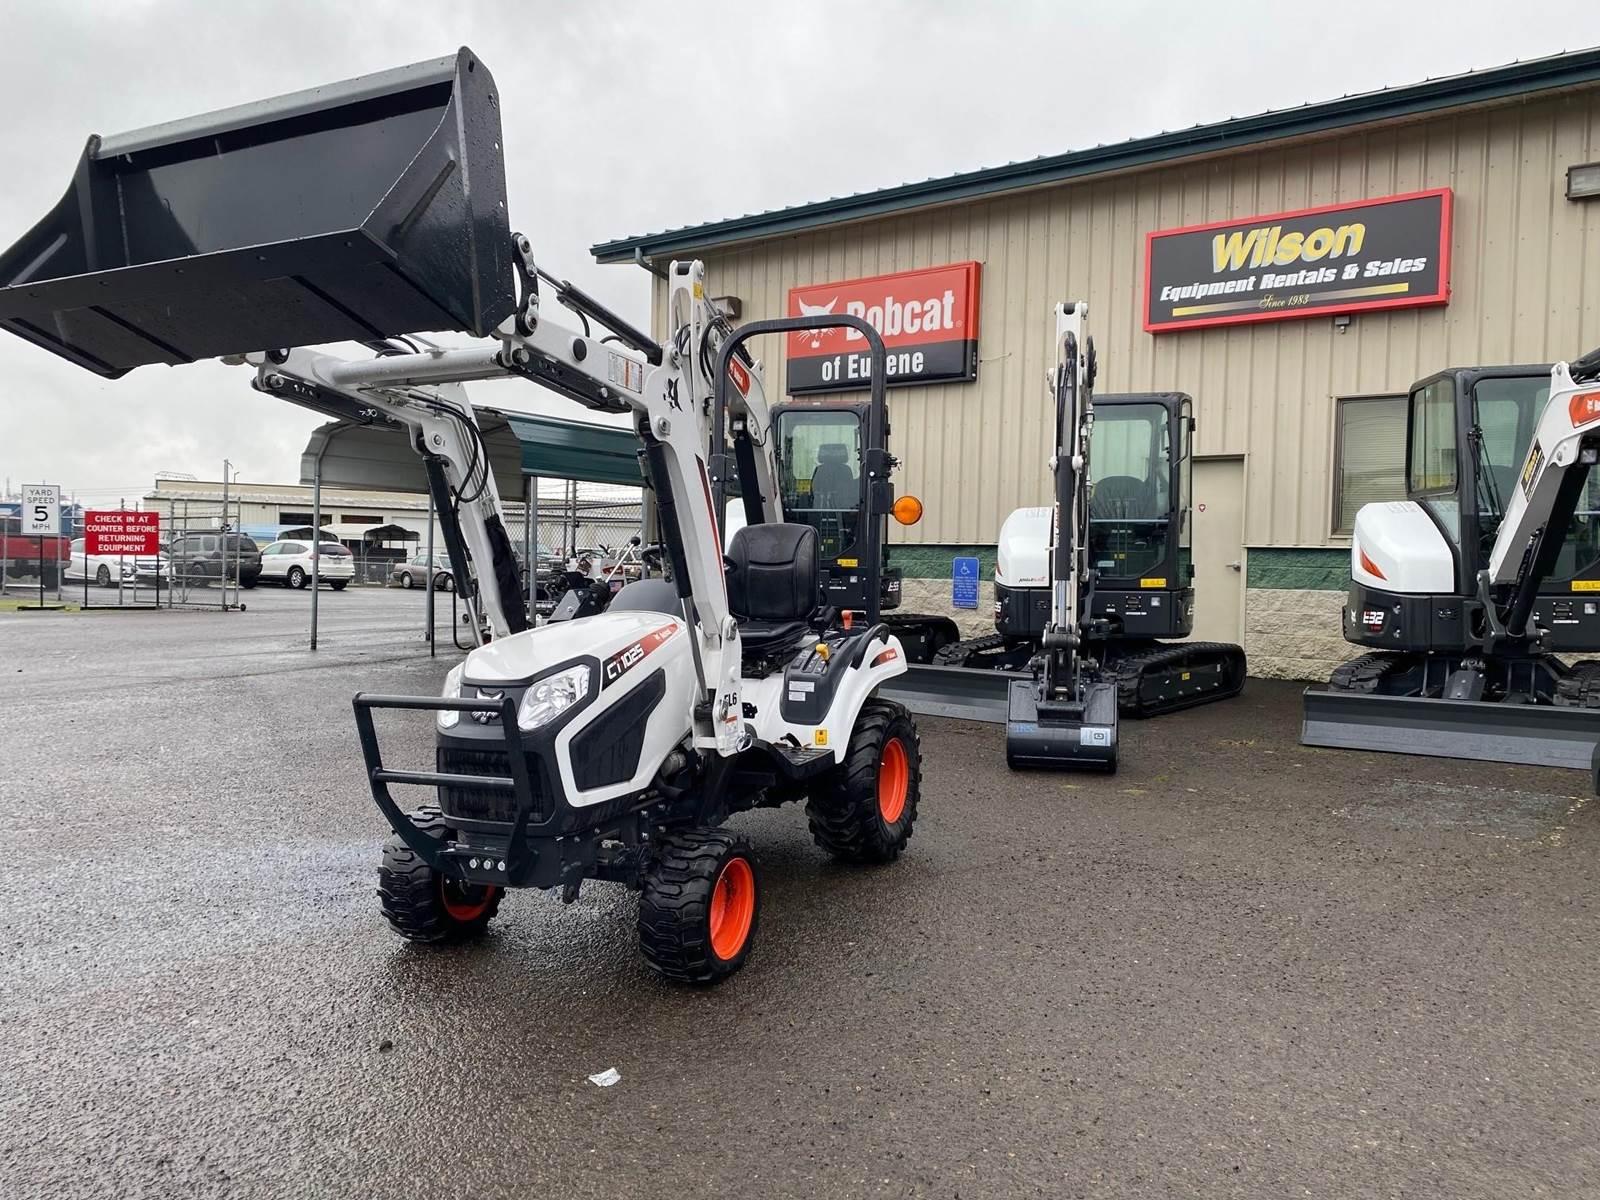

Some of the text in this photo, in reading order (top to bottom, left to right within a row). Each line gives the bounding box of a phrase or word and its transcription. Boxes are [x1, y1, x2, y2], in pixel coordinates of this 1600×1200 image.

[1212, 222, 1366, 273] Wilson
[1160, 256, 1427, 301] Equipment Rentals & Sales
[1258, 293, 1310, 309] Since 1983
[846, 290, 955, 341] Bobcat
[821, 351, 924, 381] of Euene
[34, 505, 49, 522] 5
[94, 515, 149, 523] CHECK IN AT
[31, 523, 50, 531] MPH
[98, 534, 146, 542] RETURNING
[98, 544, 146, 552] EQUIPMENT
[1362, 611, 1385, 625] E32
